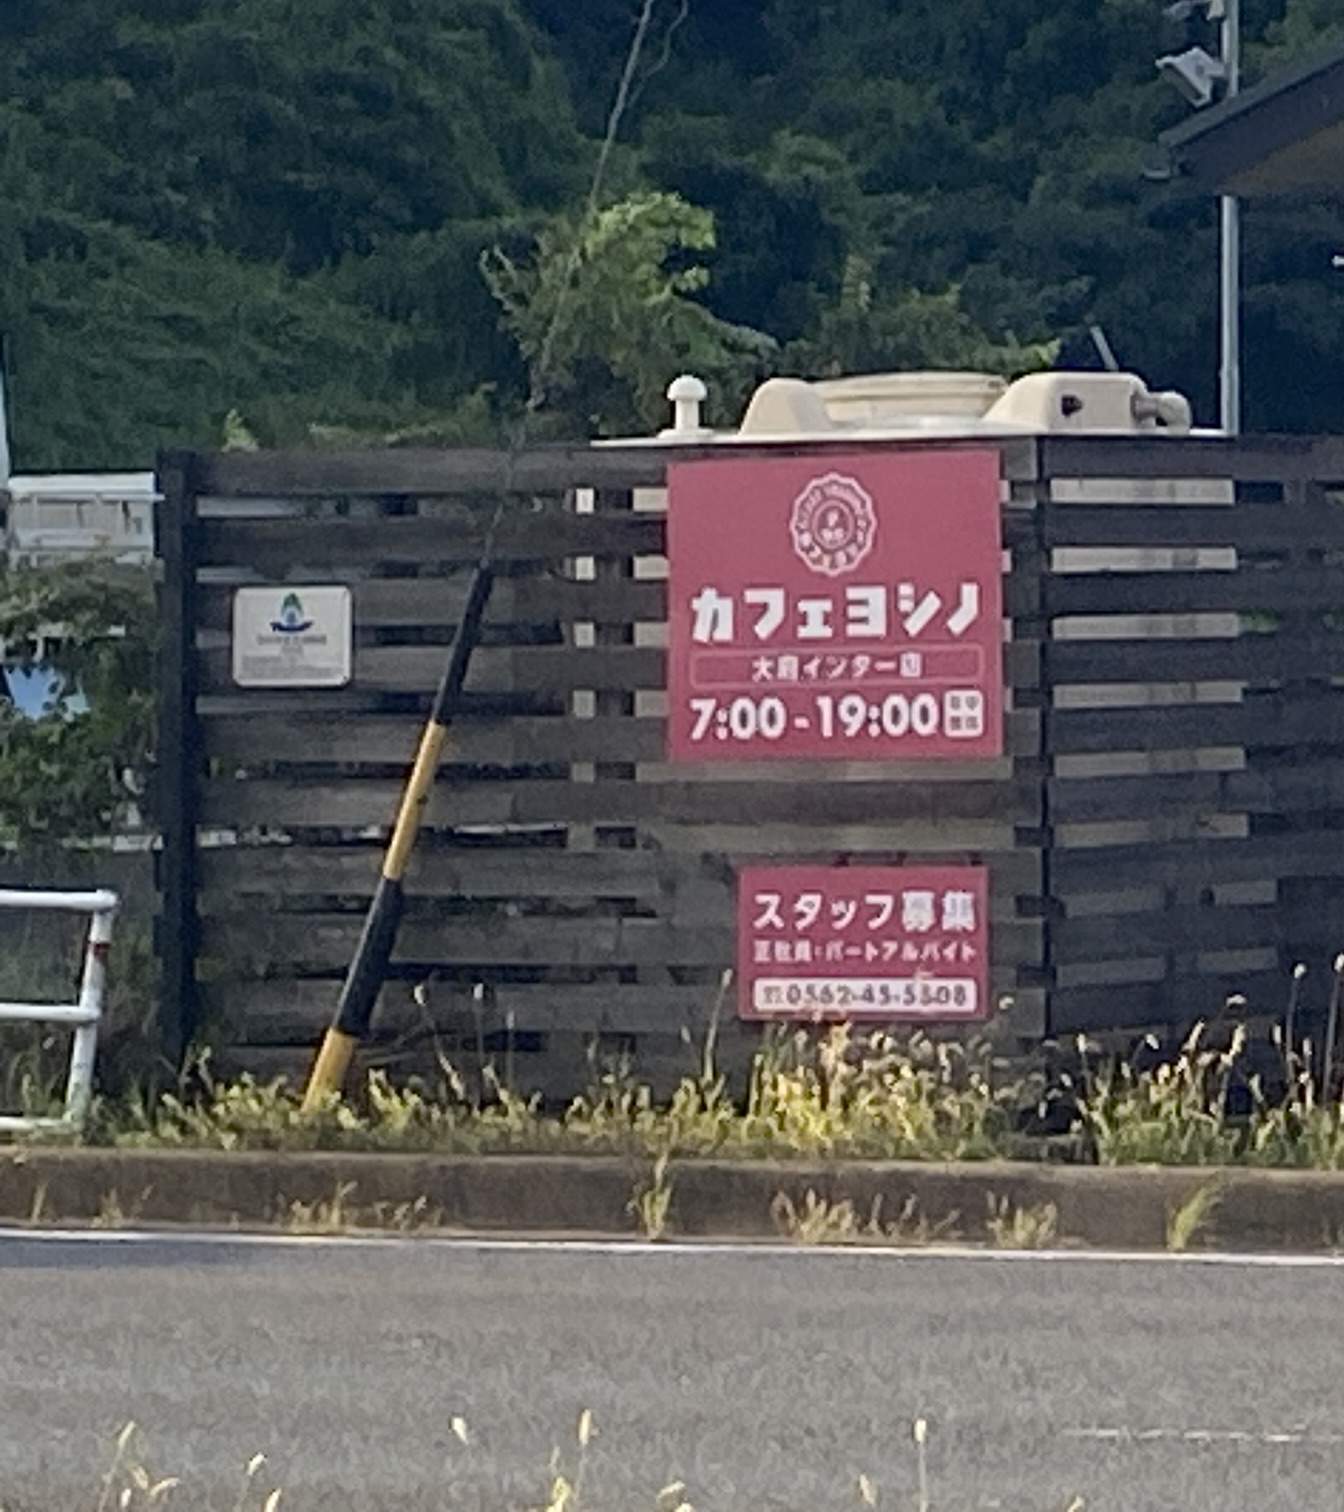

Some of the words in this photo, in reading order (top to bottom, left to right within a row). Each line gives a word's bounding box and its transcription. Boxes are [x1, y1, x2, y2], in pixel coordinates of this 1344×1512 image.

[691, 582, 979, 643] カフェヨシノ
[753, 890, 976, 933] スタッフ募集
